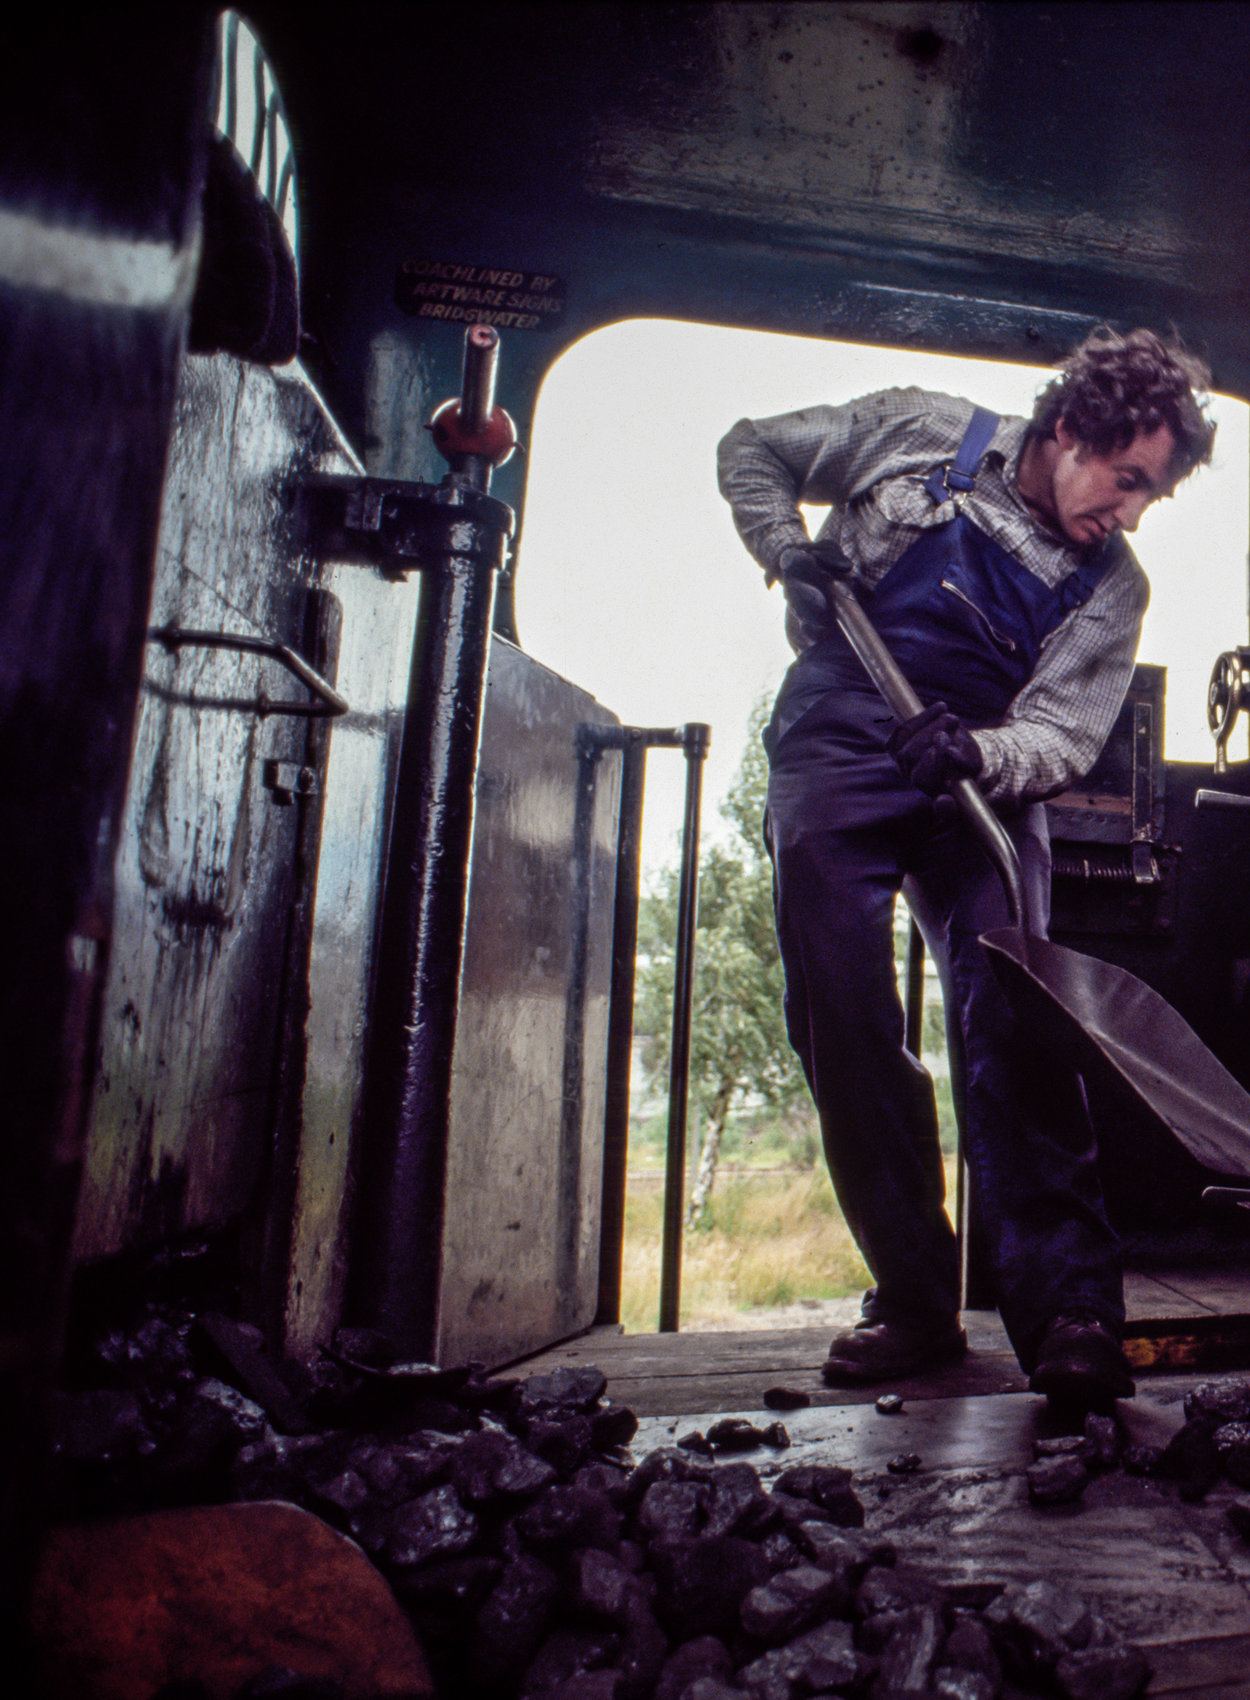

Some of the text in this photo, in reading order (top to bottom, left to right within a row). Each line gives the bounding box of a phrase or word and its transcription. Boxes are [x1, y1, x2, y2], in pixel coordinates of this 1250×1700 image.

[401, 260, 556, 291] COACHLINED BY
[412, 281, 563, 312] ARTWARE SIGNS
[419, 303, 541, 329] BRIDGWATER
